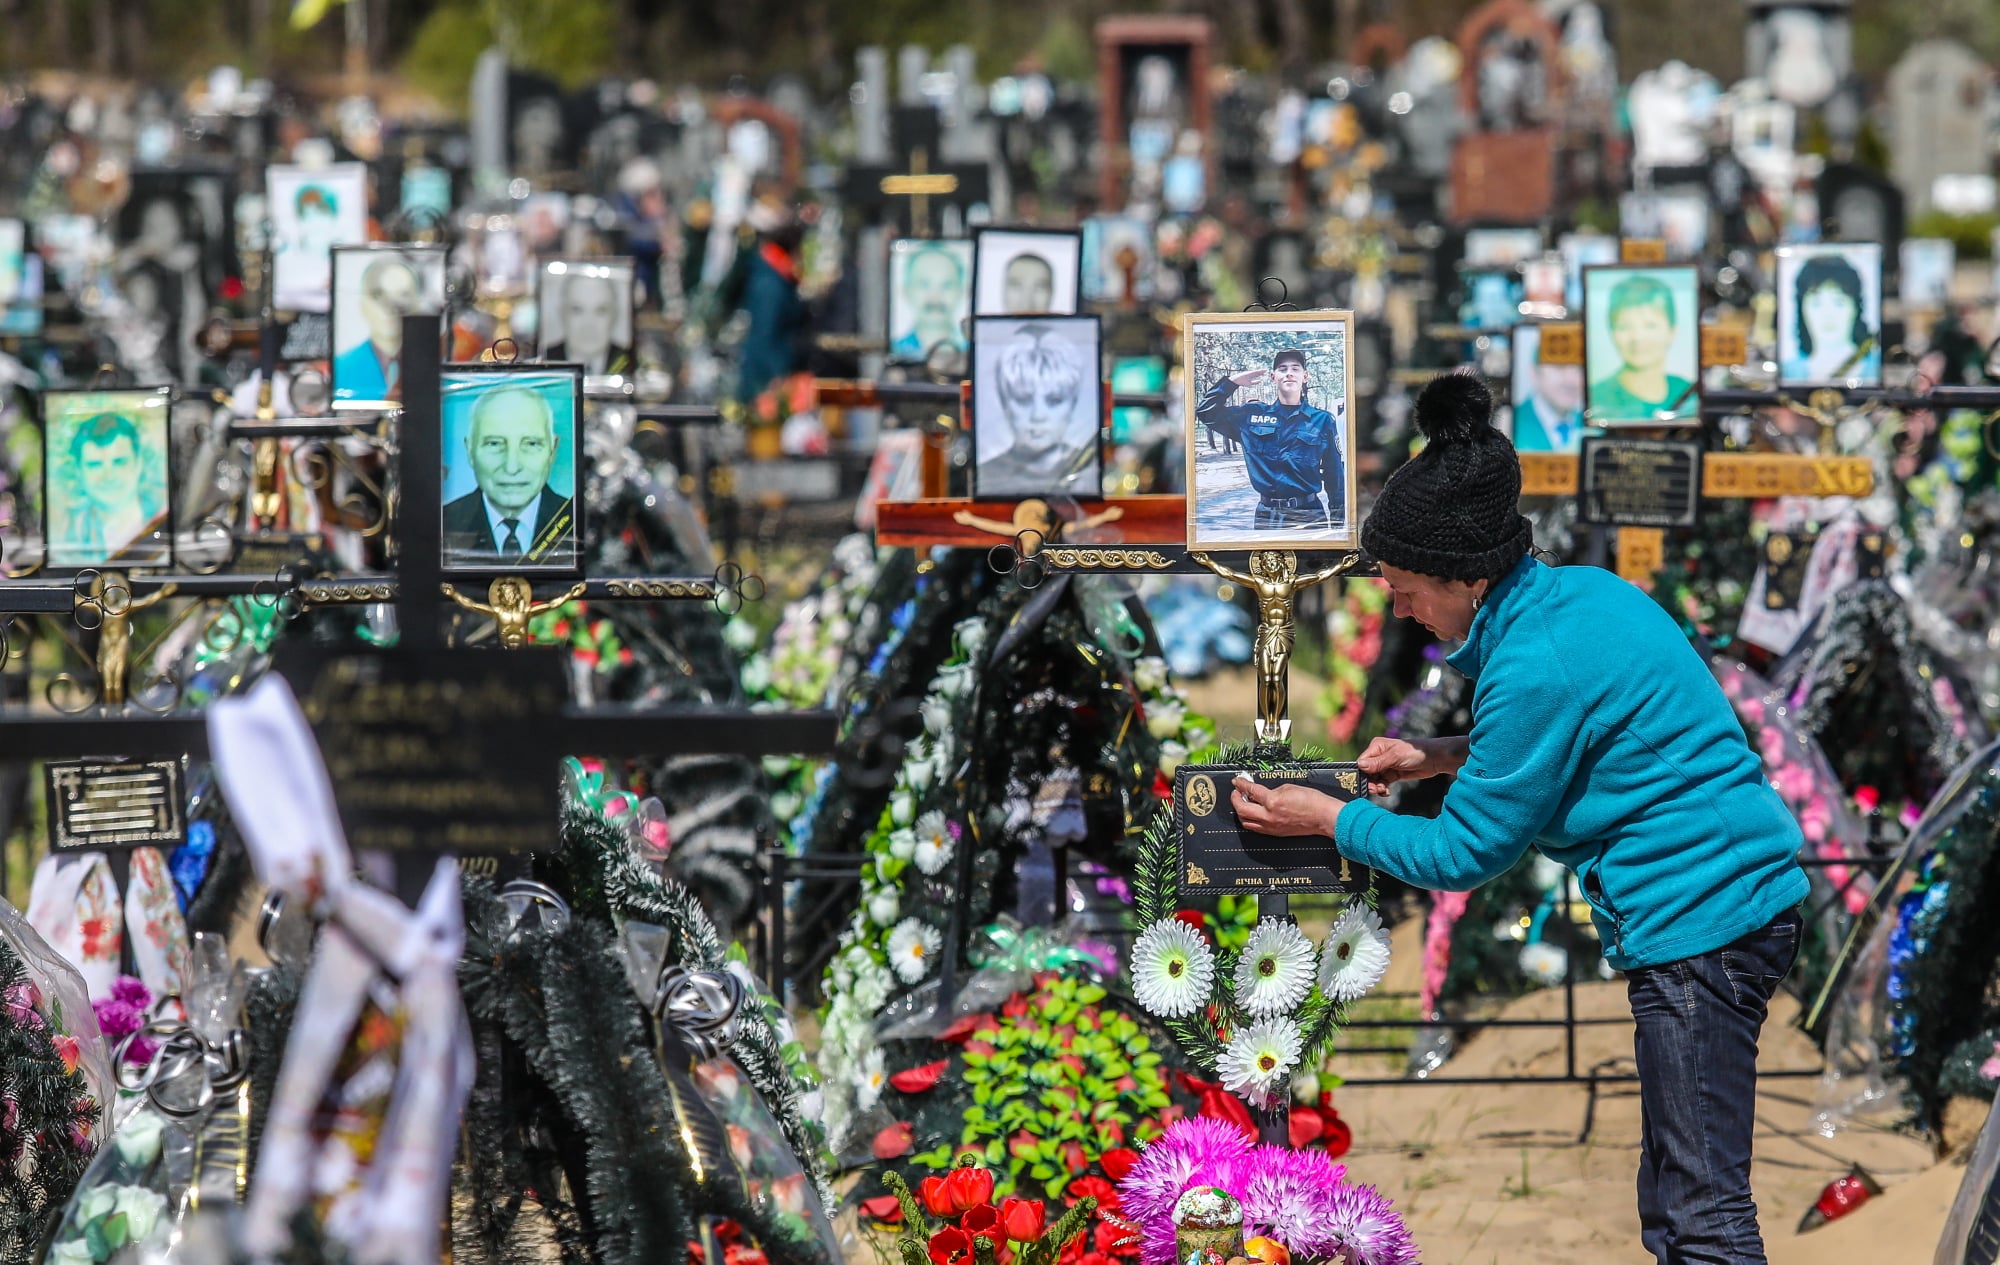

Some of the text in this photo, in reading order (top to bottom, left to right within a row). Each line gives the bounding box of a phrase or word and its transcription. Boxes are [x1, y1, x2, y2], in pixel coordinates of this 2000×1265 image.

[1250, 414, 1278, 424] БАРС
[1235, 877, 1312, 885] ВІЧНА ПАМ'ЯТЬ
